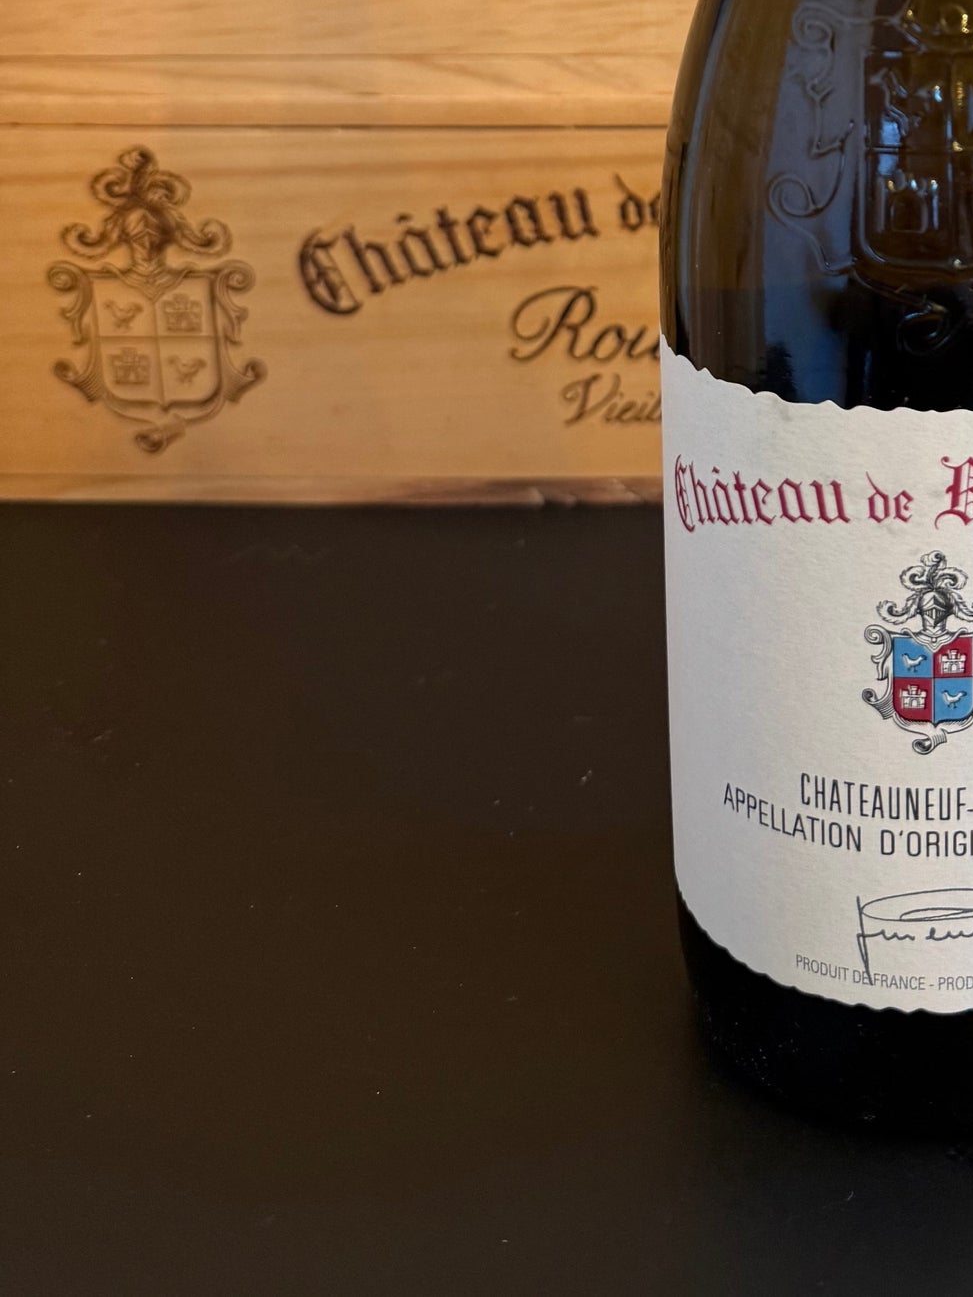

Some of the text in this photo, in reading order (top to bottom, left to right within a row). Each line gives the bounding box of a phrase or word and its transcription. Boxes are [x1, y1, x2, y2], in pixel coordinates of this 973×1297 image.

[298, 186, 600, 315] Château
[674, 454, 850, 533] Château
[865, 471, 914, 523] de
[723, 783, 862, 852] APPELLATION
[796, 954, 849, 982] PRODUIT
[853, 969, 872, 985] DE
[873, 973, 926, 990] FRANCE
